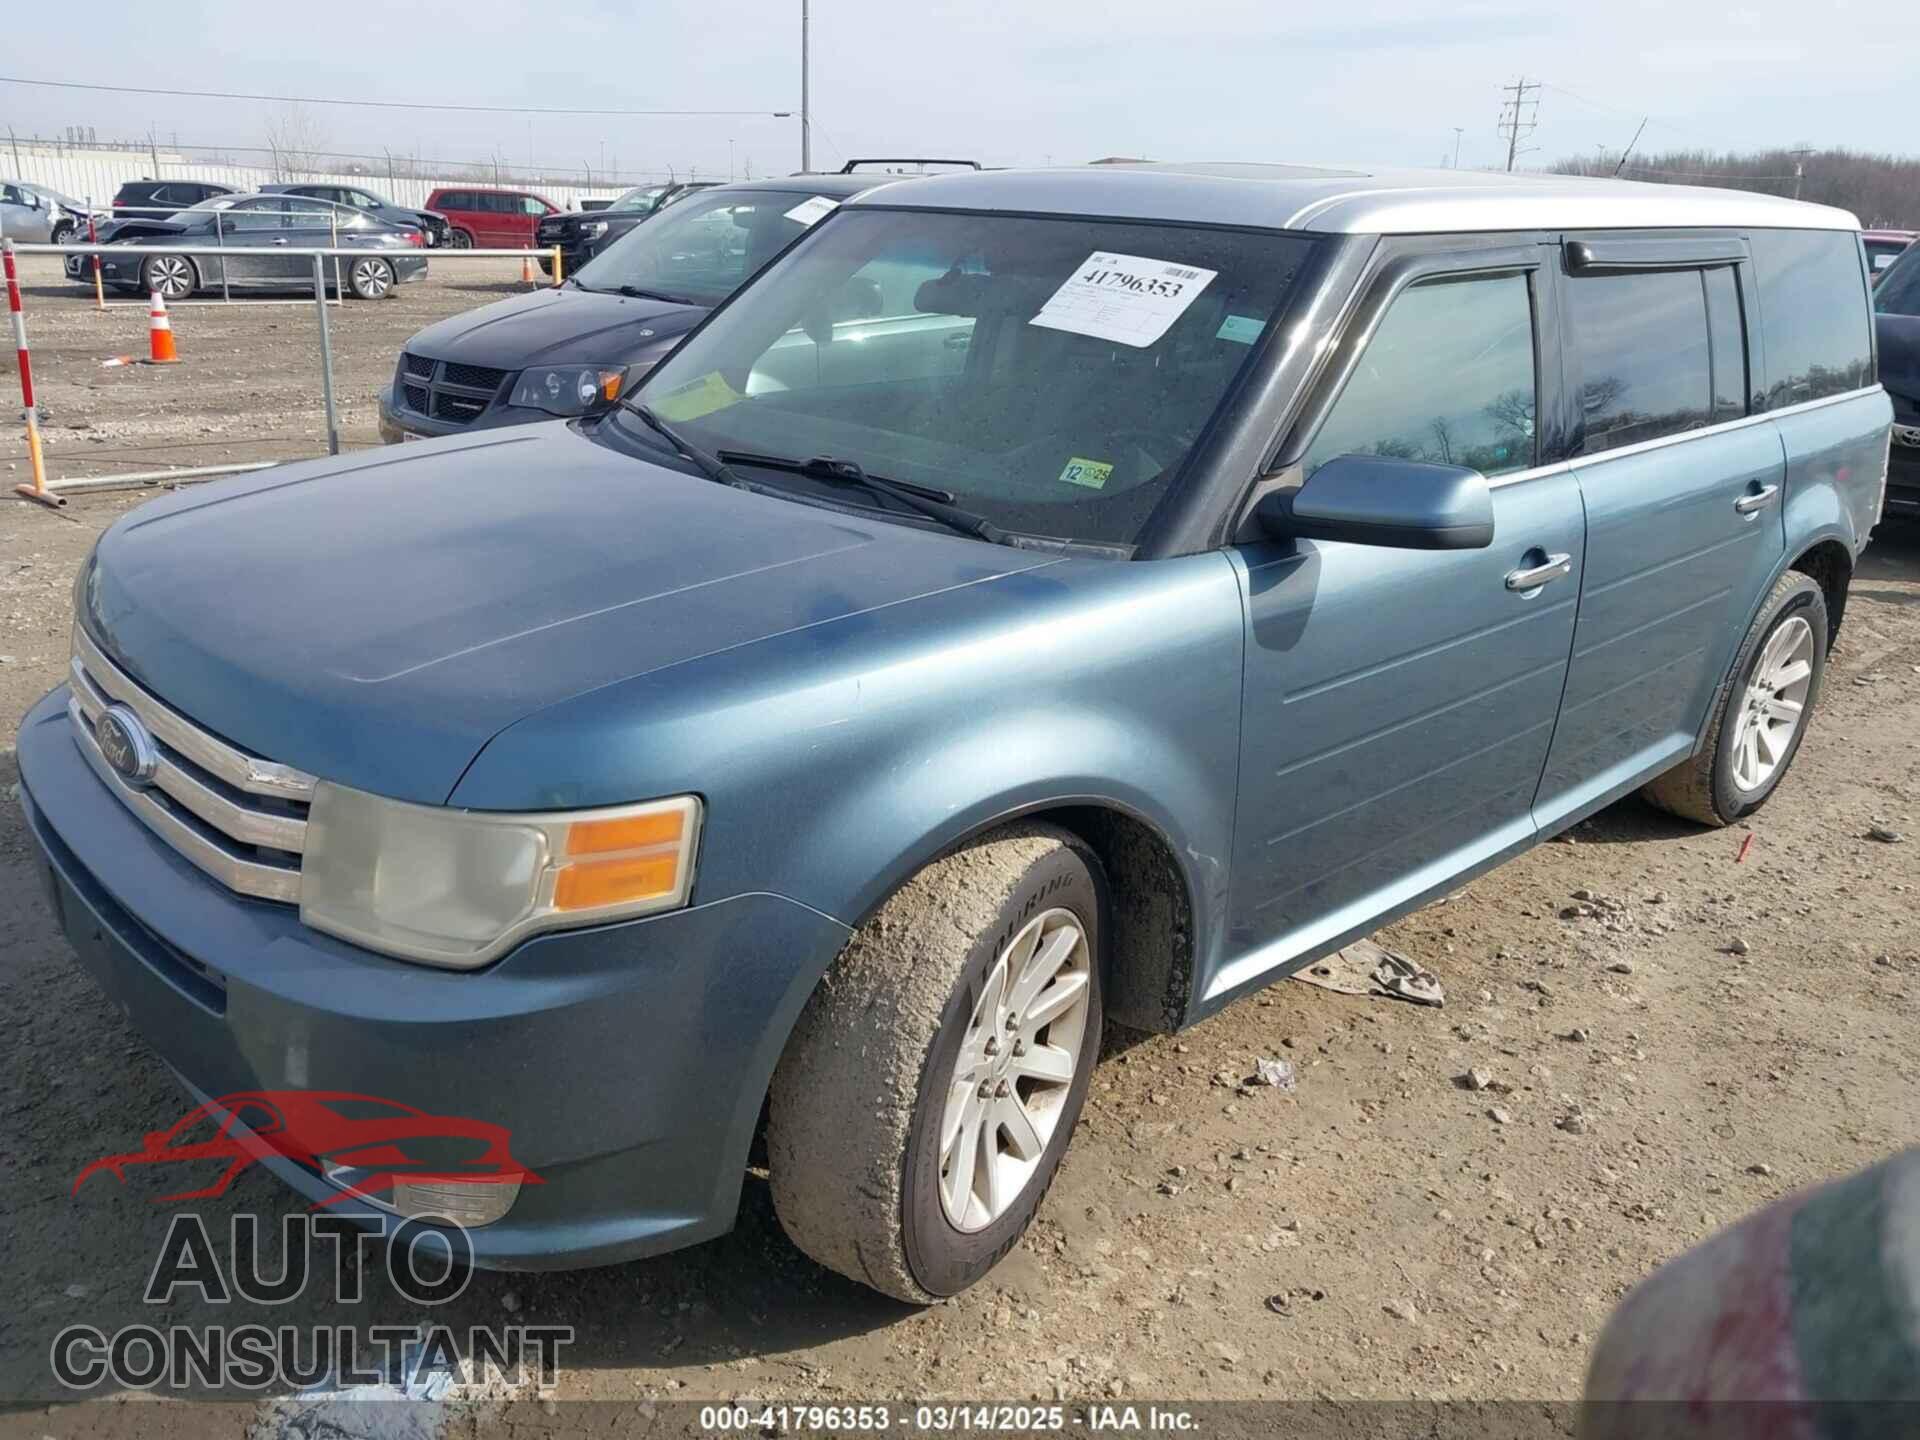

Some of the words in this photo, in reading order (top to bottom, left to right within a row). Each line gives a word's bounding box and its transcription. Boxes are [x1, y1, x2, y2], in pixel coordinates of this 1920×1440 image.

[1083, 269, 1184, 298] 41796353
[1066, 464, 1083, 481] 12
[102, 719, 128, 766] Ford
